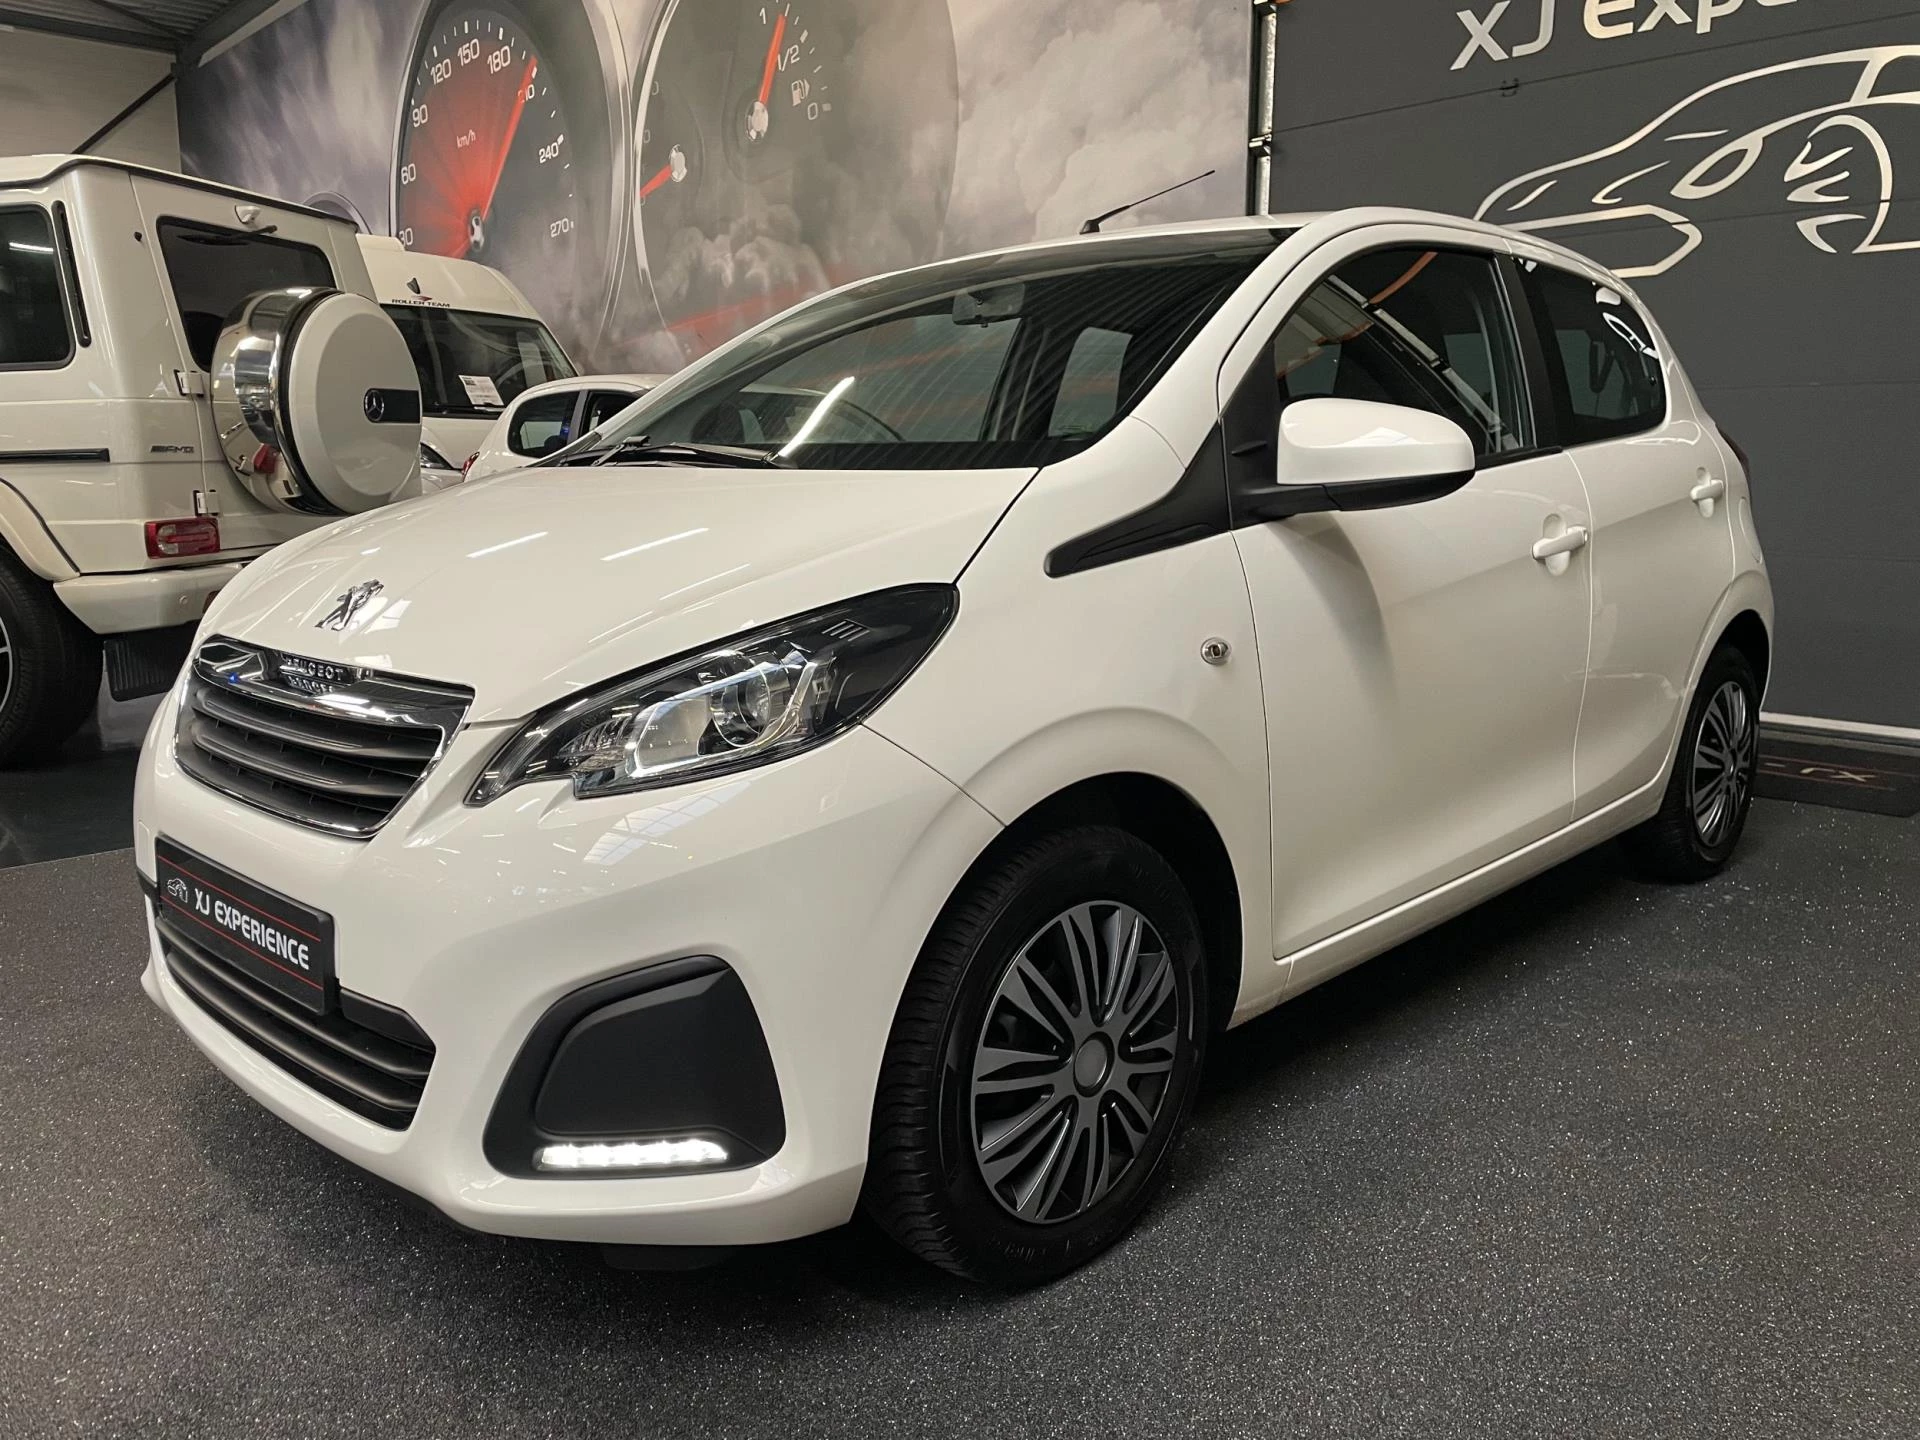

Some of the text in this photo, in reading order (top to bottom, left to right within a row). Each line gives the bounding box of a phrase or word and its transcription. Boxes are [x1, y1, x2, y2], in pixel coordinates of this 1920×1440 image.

[759, 7, 767, 25] 1
[457, 38, 480, 67] 150
[486, 45, 511, 74] 180
[777, 44, 801, 72] 1/2
[430, 58, 452, 85] 120
[412, 104, 429, 128] 90
[807, 103, 819, 121] 0
[456, 129, 477, 148] km/h
[539, 142, 560, 164] 240
[401, 163, 417, 185] 60
[399, 227, 414, 246] 30
[550, 218, 570, 238] 270
[391, 298, 425, 306] ROLLER
[164, 445, 195, 454] AMG
[194, 888, 310, 971] XJ EXPERIENCE
